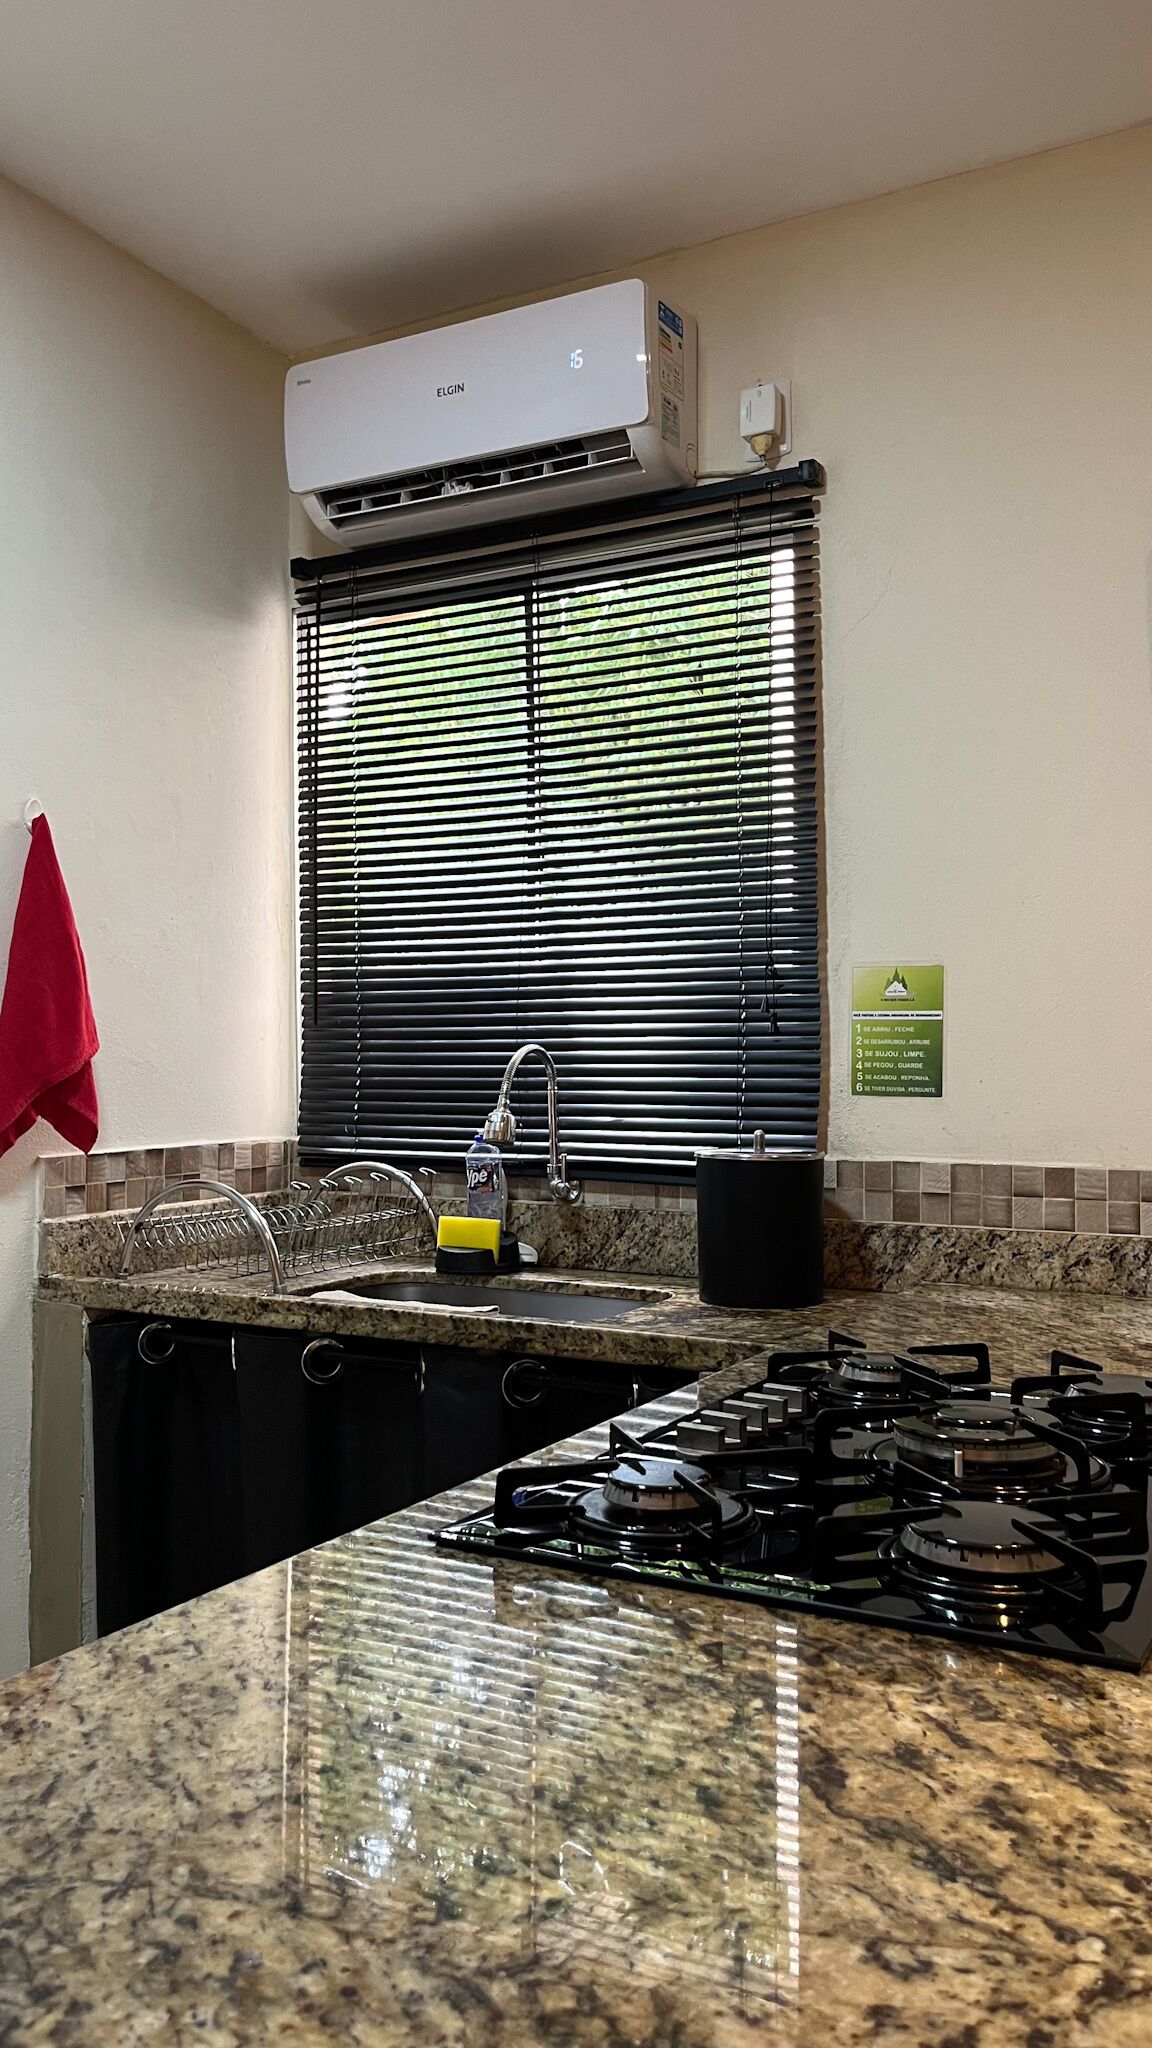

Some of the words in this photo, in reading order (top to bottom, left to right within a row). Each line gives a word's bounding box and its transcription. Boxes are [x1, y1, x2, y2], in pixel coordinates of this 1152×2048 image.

[570, 349, 584, 369] 16
[437, 382, 465, 397] ELGIN
[855, 1023, 861, 1033] 1
[856, 1036, 862, 1045] 2
[856, 1048, 863, 1058] 3
[856, 1061, 863, 1070] 4
[857, 1072, 863, 1081] 5
[856, 1082, 863, 1092] 6
